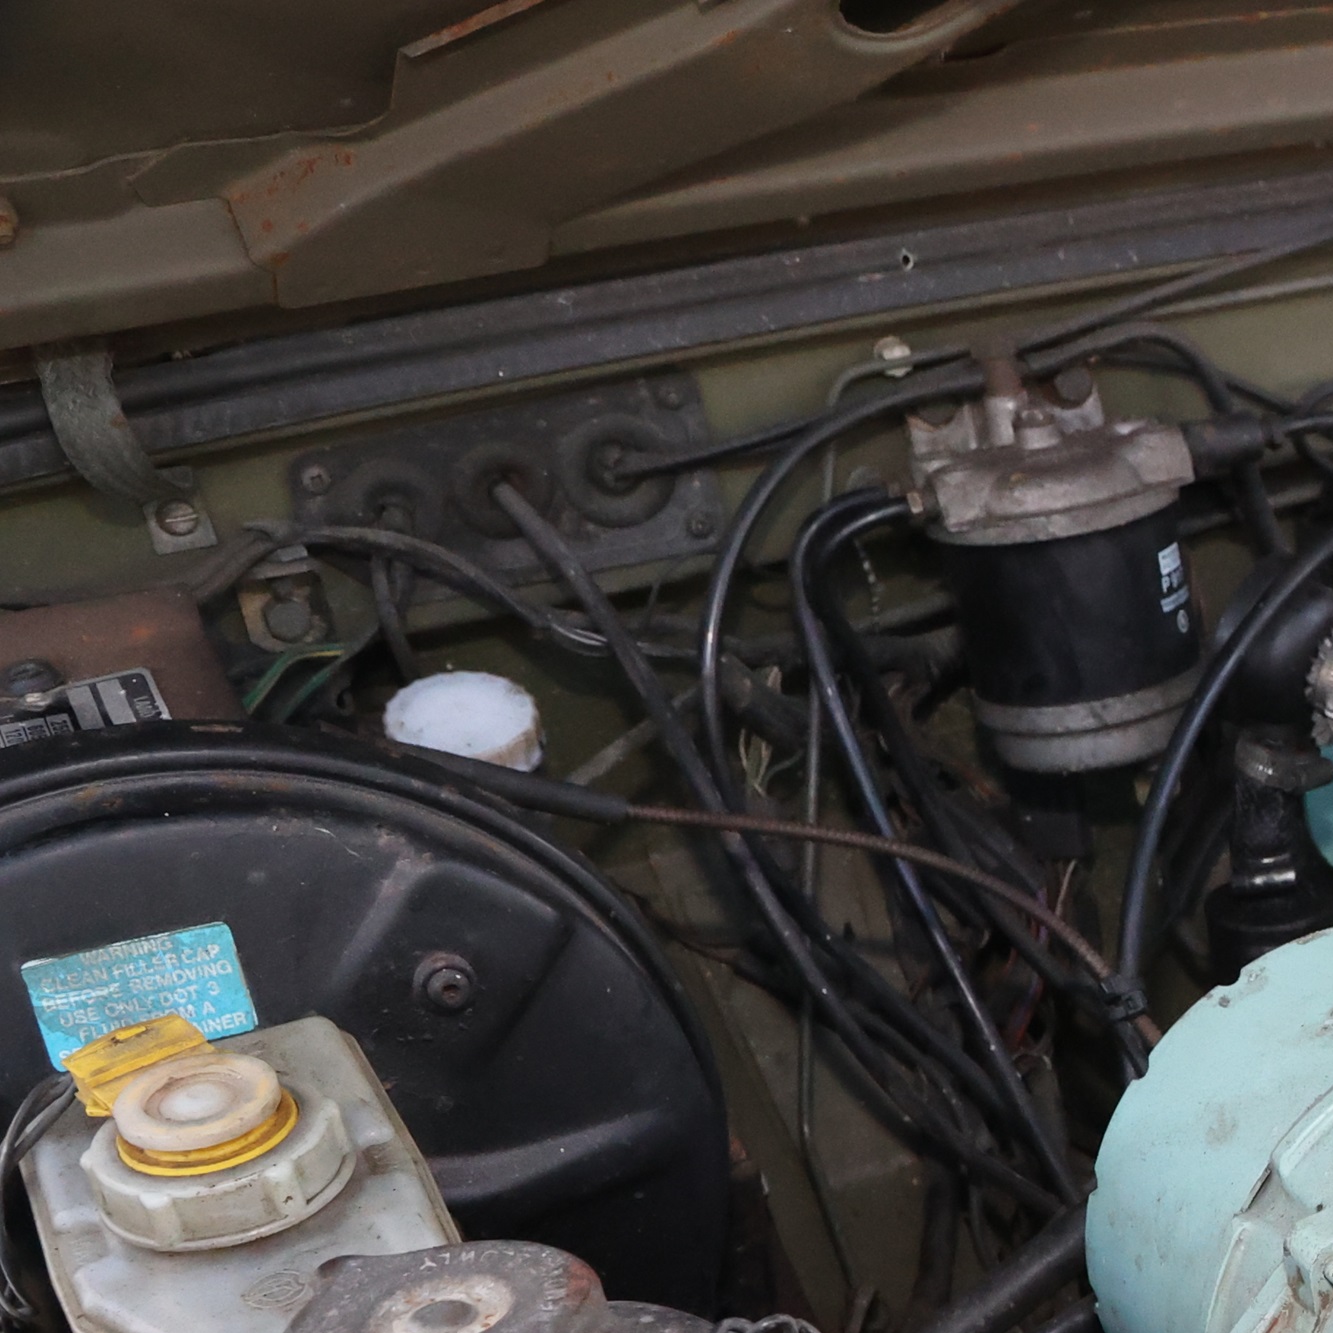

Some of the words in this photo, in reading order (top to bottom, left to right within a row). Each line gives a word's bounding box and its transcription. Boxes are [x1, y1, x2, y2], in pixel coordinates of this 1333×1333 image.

[41, 967, 109, 994] CLEAN
[112, 953, 180, 979] FILLER
[181, 944, 219, 965] CAP
[80, 936, 173, 967] WARNING
[42, 982, 123, 1012] BEFORE
[129, 960, 233, 994] REMOVING
[60, 1006, 100, 1028] USE
[105, 996, 157, 1018] ONLY
[160, 985, 198, 1007] DOT
[207, 981, 220, 996] 3
[202, 1001, 216, 1016] A
